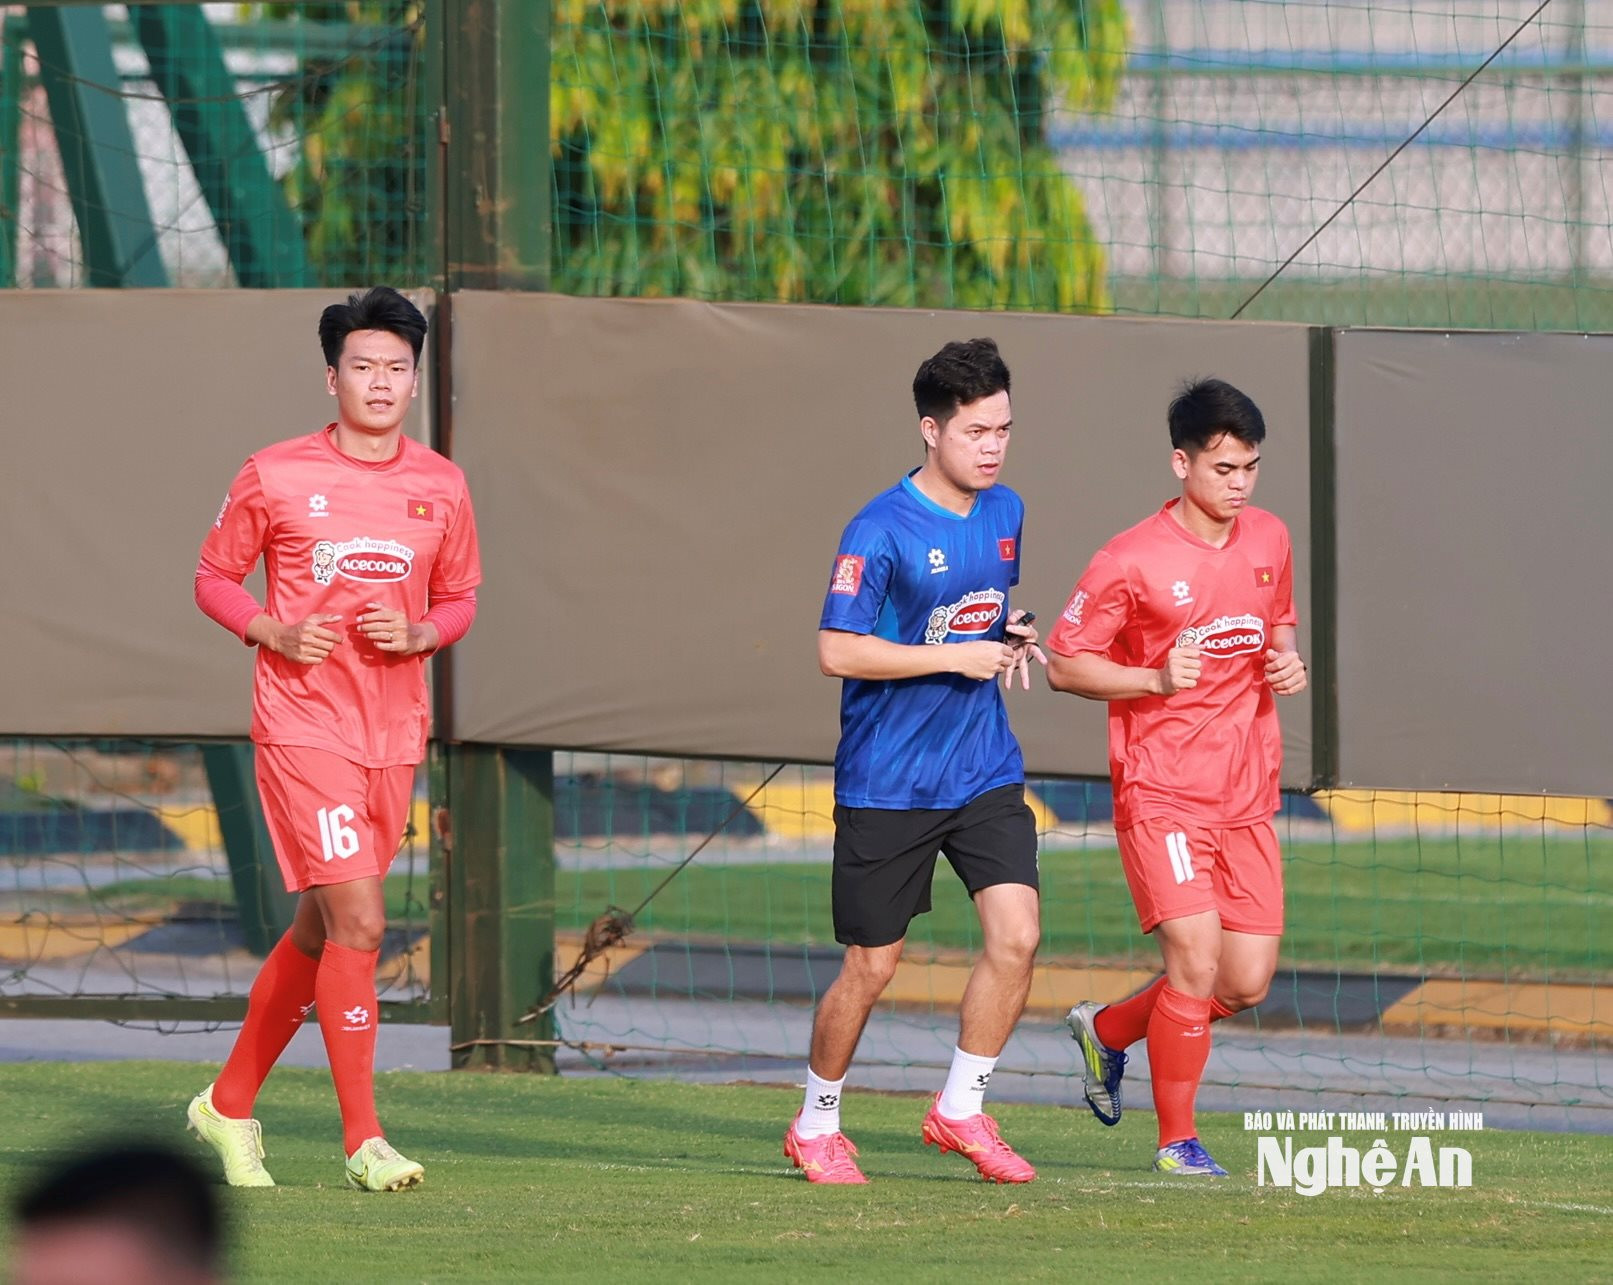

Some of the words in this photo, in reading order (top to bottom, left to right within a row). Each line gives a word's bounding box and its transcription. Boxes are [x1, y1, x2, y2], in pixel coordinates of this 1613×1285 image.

[336, 539, 361, 553] Cook
[364, 539, 413, 559] happiness
[948, 596, 968, 614] Cook
[1198, 620, 1222, 636] Cook
[316, 803, 361, 864] 16
[1165, 831, 1196, 886] 11
